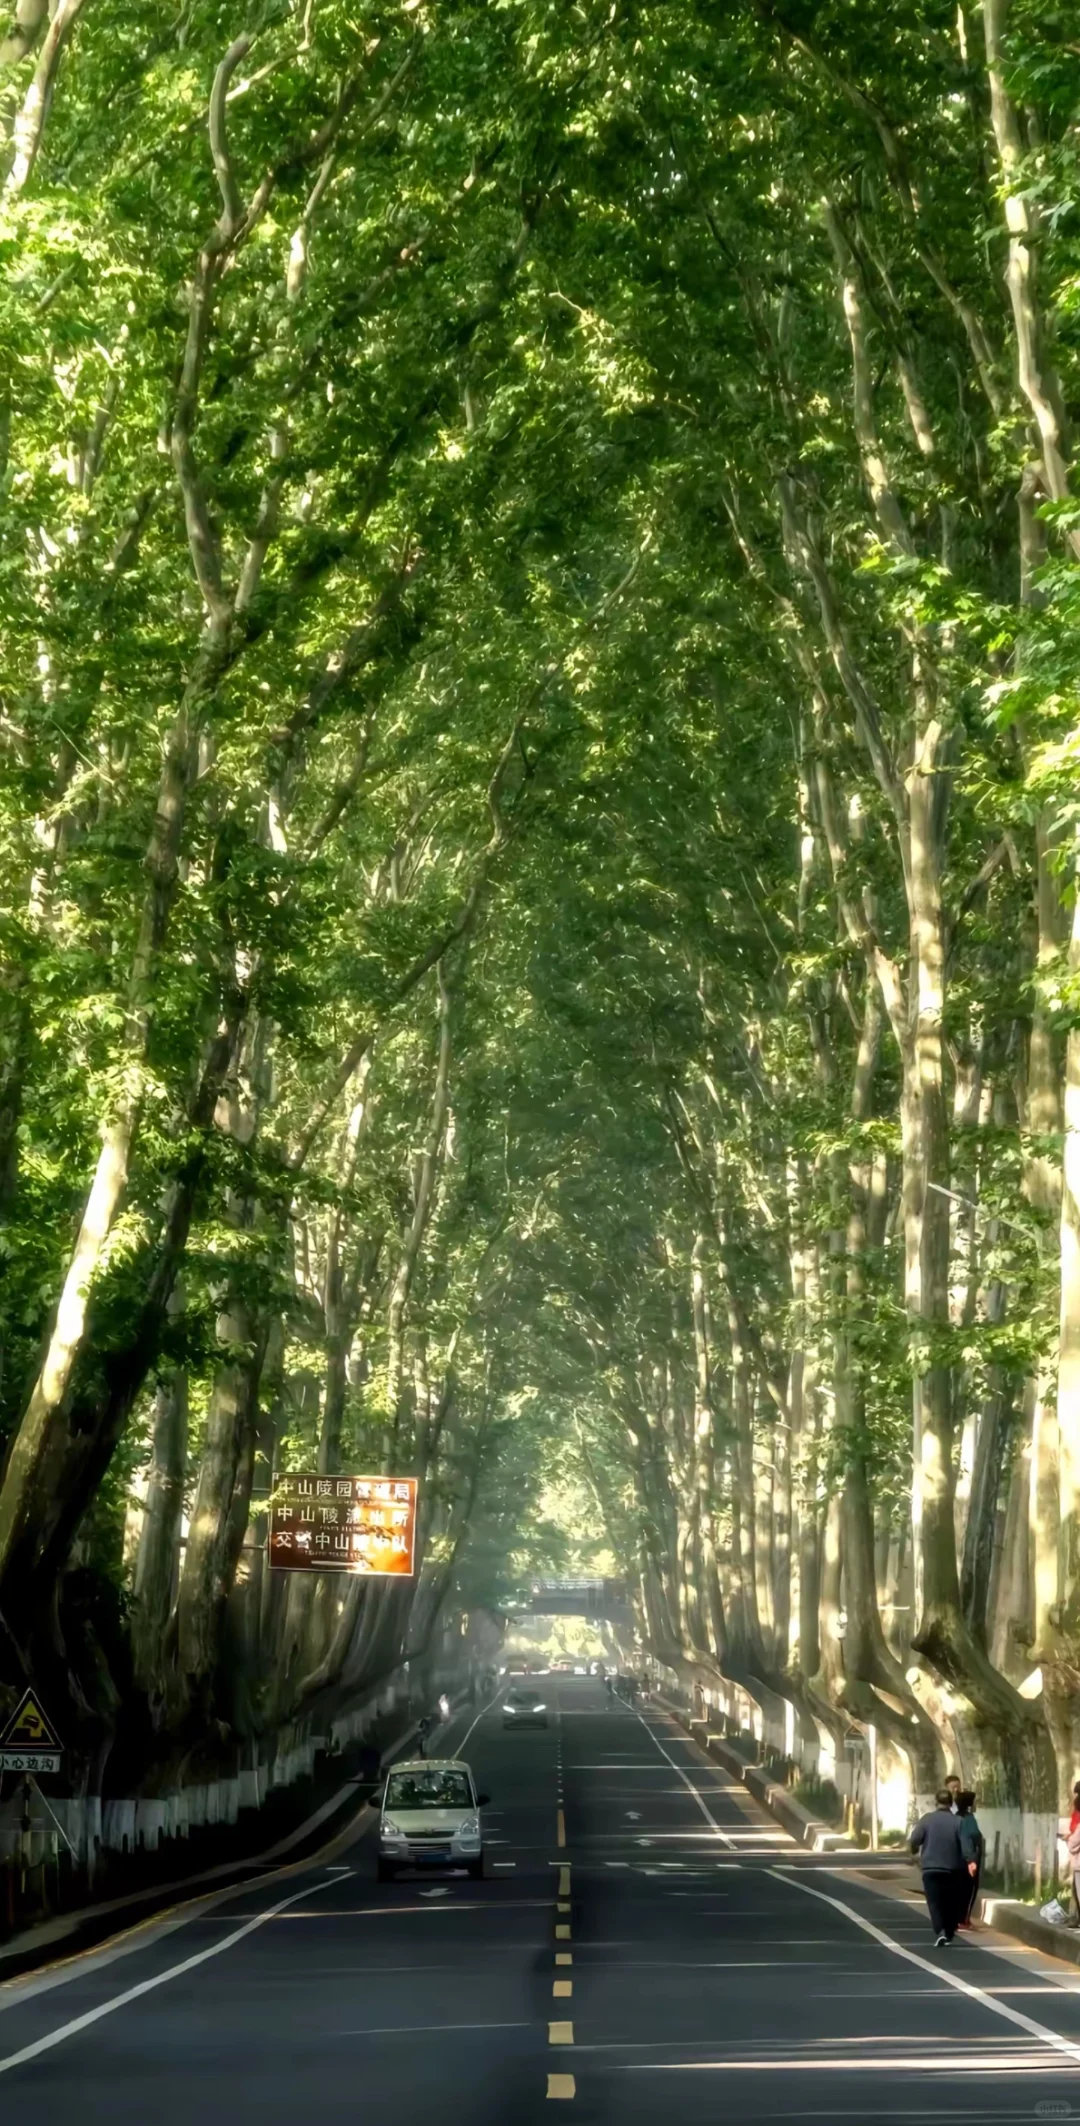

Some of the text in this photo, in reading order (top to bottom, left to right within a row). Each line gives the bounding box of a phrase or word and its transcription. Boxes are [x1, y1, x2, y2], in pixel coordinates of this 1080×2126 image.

[278, 1478, 410, 1499] 中山陵园局
[276, 1531, 408, 1553] 交警中山队
